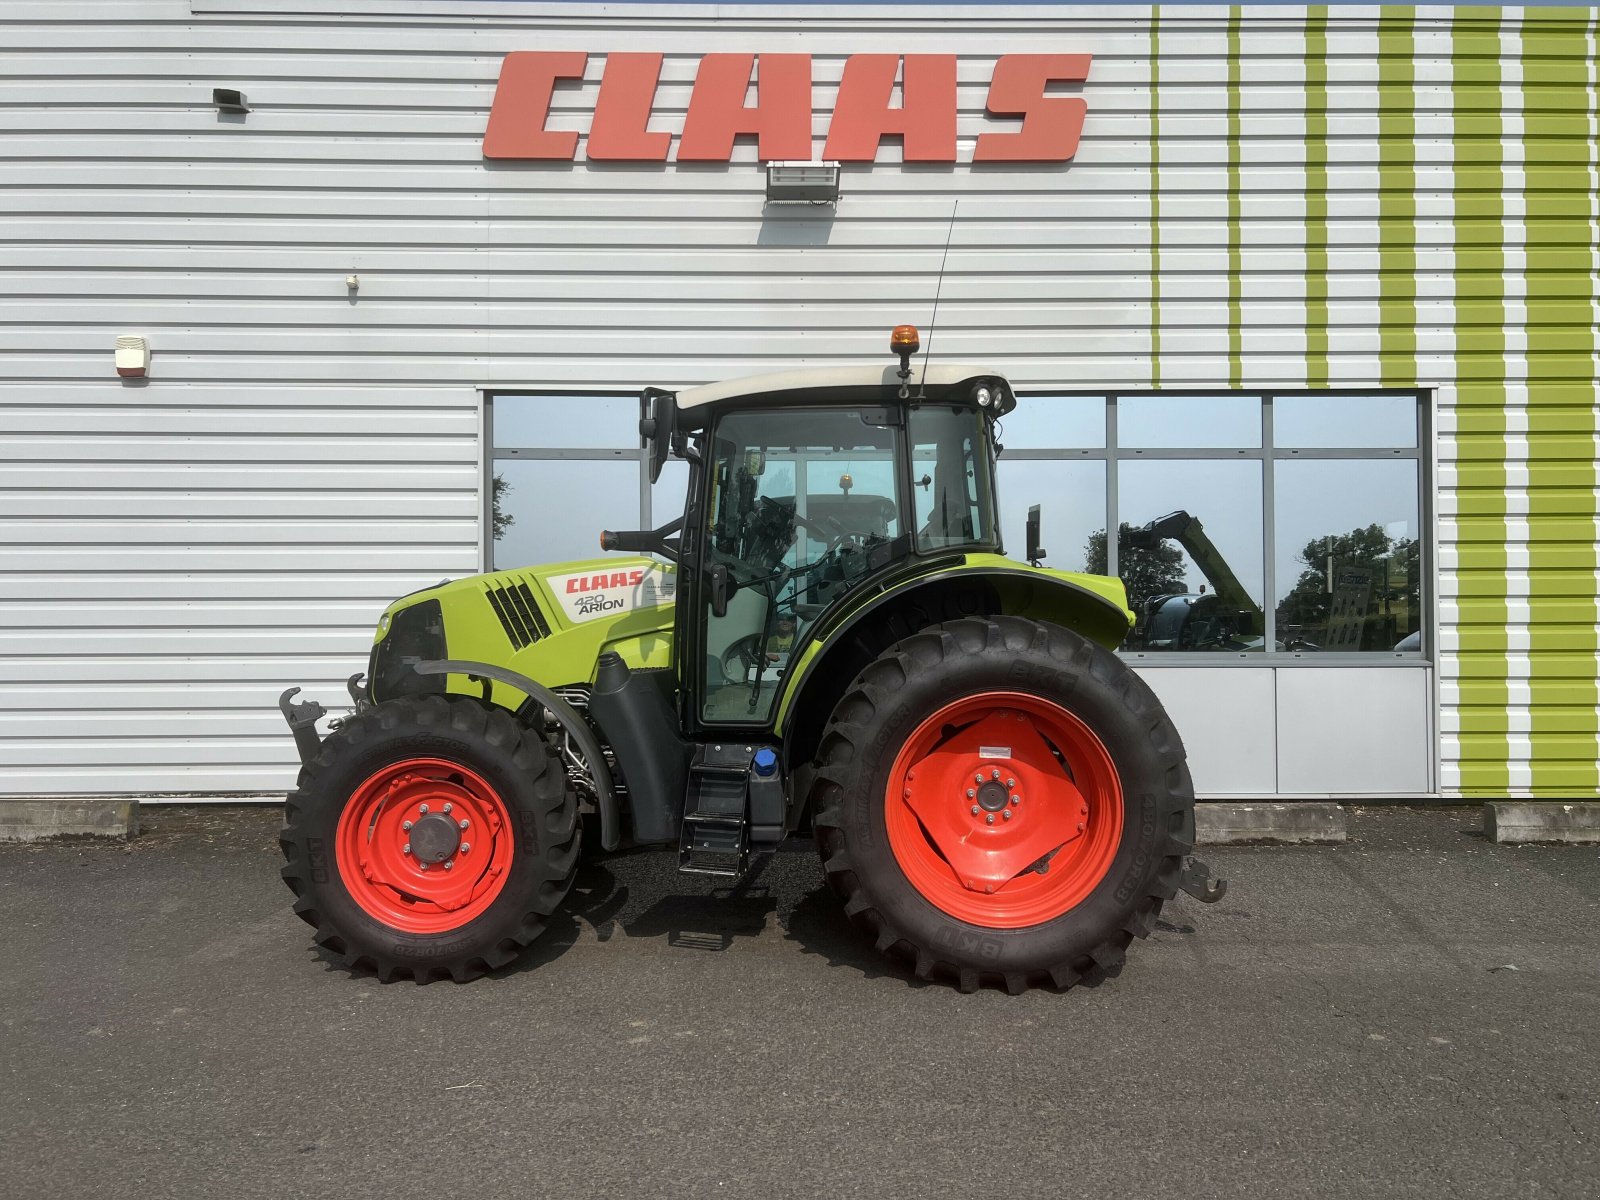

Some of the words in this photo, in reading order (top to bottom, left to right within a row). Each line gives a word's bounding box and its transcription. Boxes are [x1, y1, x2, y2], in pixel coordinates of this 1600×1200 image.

[482, 51, 1092, 162] CLAAS
[566, 570, 643, 594] CLAAS
[574, 594, 605, 607] 420
[578, 598, 624, 616] ARION
[931, 926, 1004, 959] BKT
